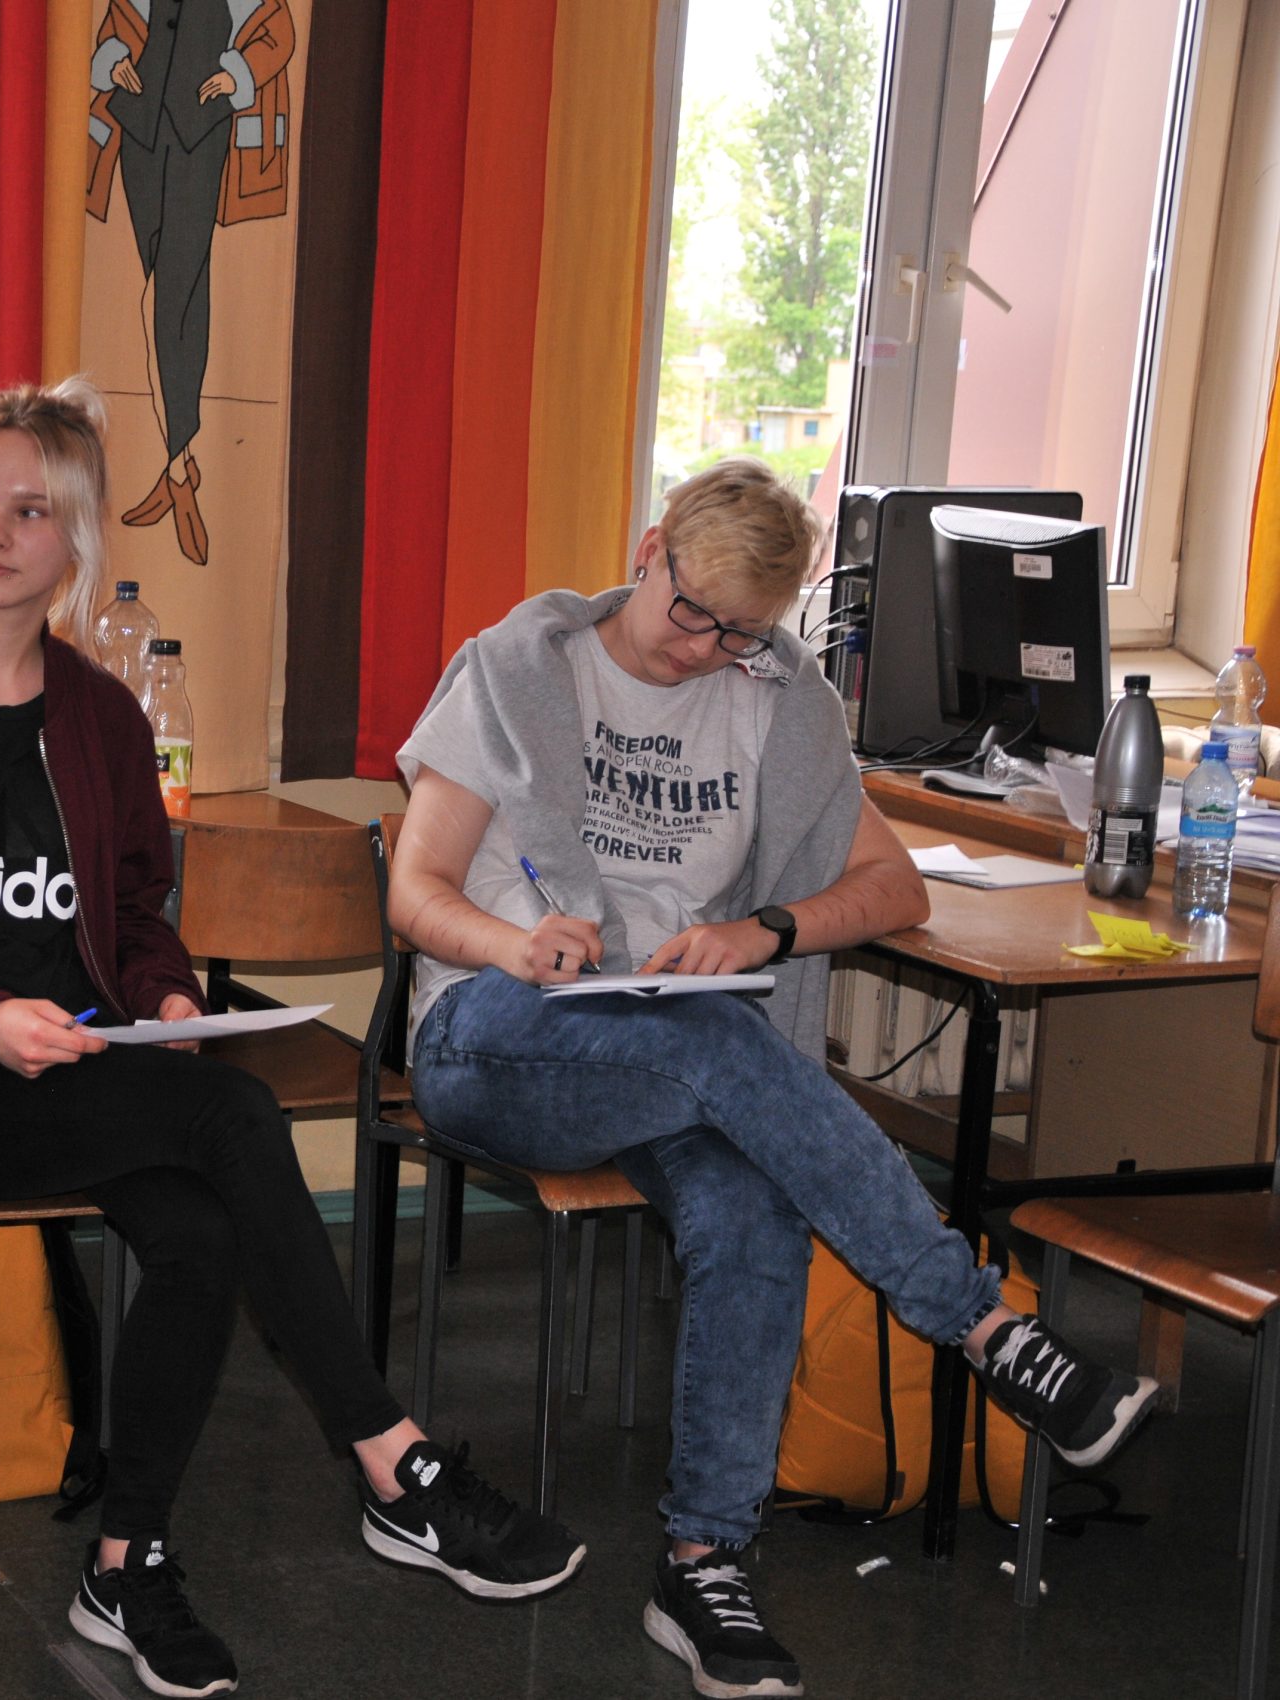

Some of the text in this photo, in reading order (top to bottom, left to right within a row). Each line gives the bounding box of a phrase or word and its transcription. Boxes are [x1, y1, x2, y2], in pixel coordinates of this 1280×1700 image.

[595, 720, 682, 759] FREEDOM
[583, 742, 693, 777] S AN OPEN ROAD
[584, 756, 739, 813] VENTURE
[616, 797, 630, 814] TO
[635, 807, 705, 827] EXPLORE
[626, 817, 648, 830] CREW
[676, 826, 713, 834] WHEELS
[582, 830, 683, 865] FOREVER
[583, 818, 598, 827] IDE
[600, 821, 611, 830] TO
[637, 834, 655, 845] LIVE
